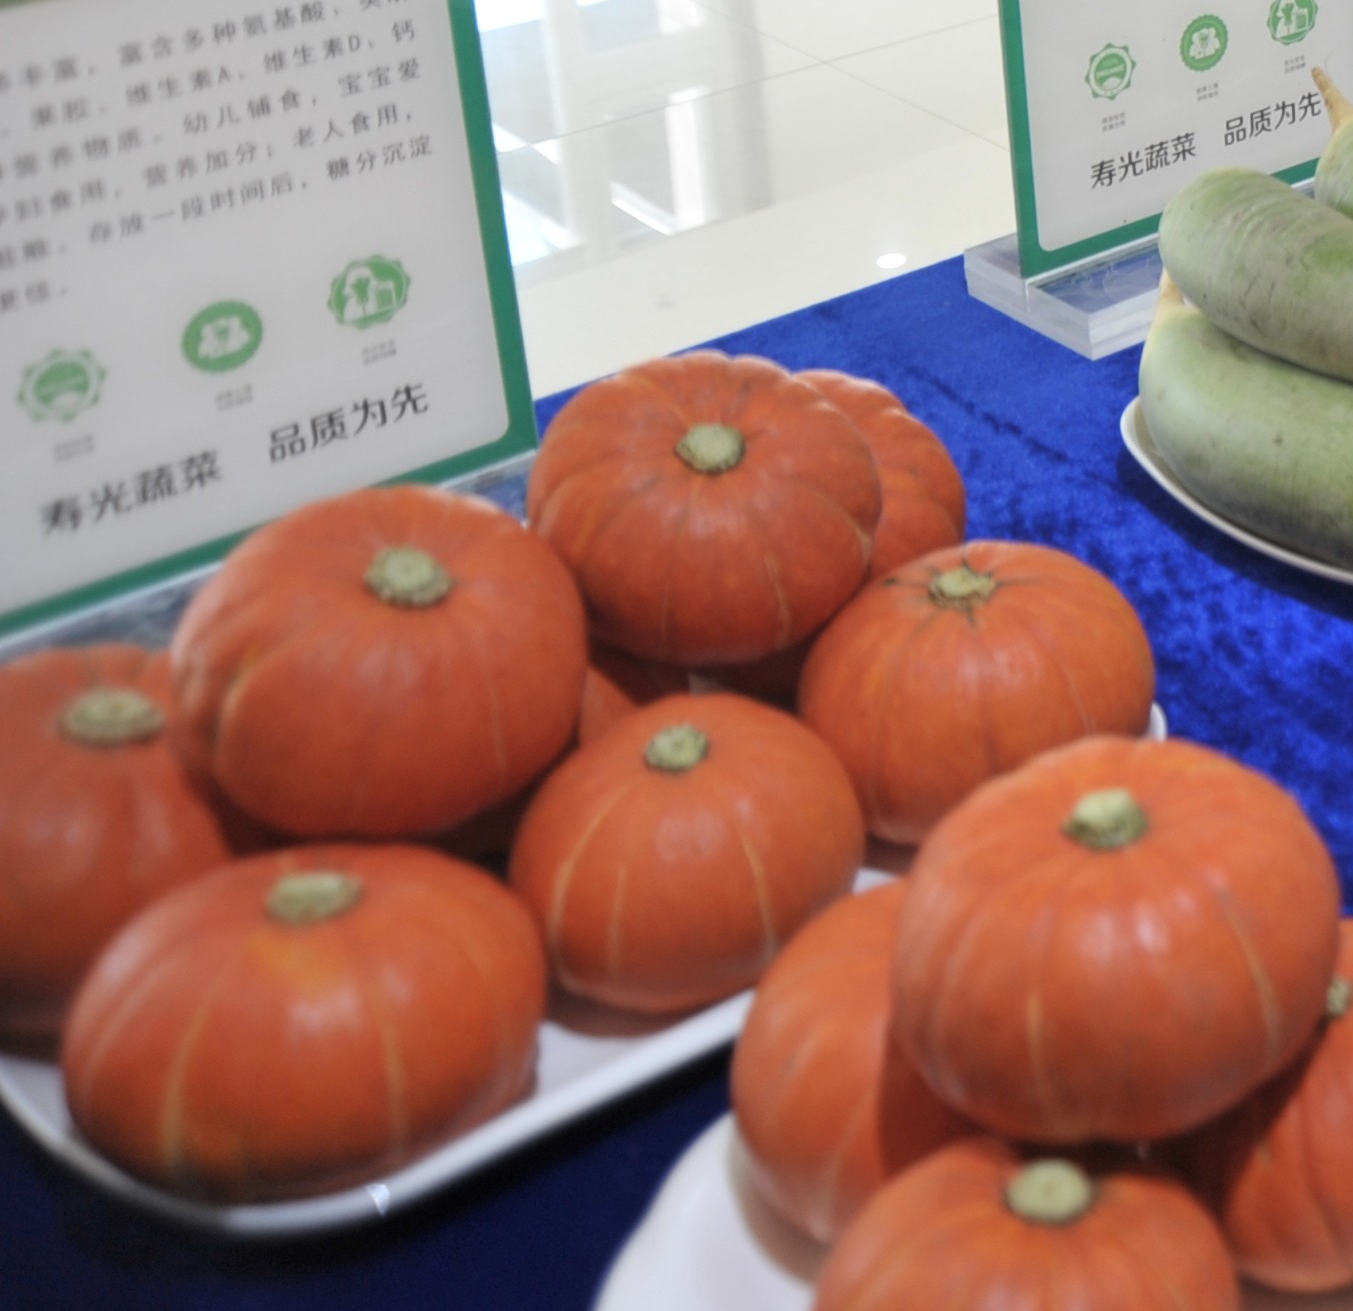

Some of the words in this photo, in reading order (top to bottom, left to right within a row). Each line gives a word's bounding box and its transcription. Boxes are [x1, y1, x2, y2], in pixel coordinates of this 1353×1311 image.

[1090, 132, 1196, 190] 寿光蔬菜
[1224, 92, 1322, 147] 品质为先
[41, 449, 222, 537] 寿光蔬菜
[269, 383, 429, 464] 品质为先
